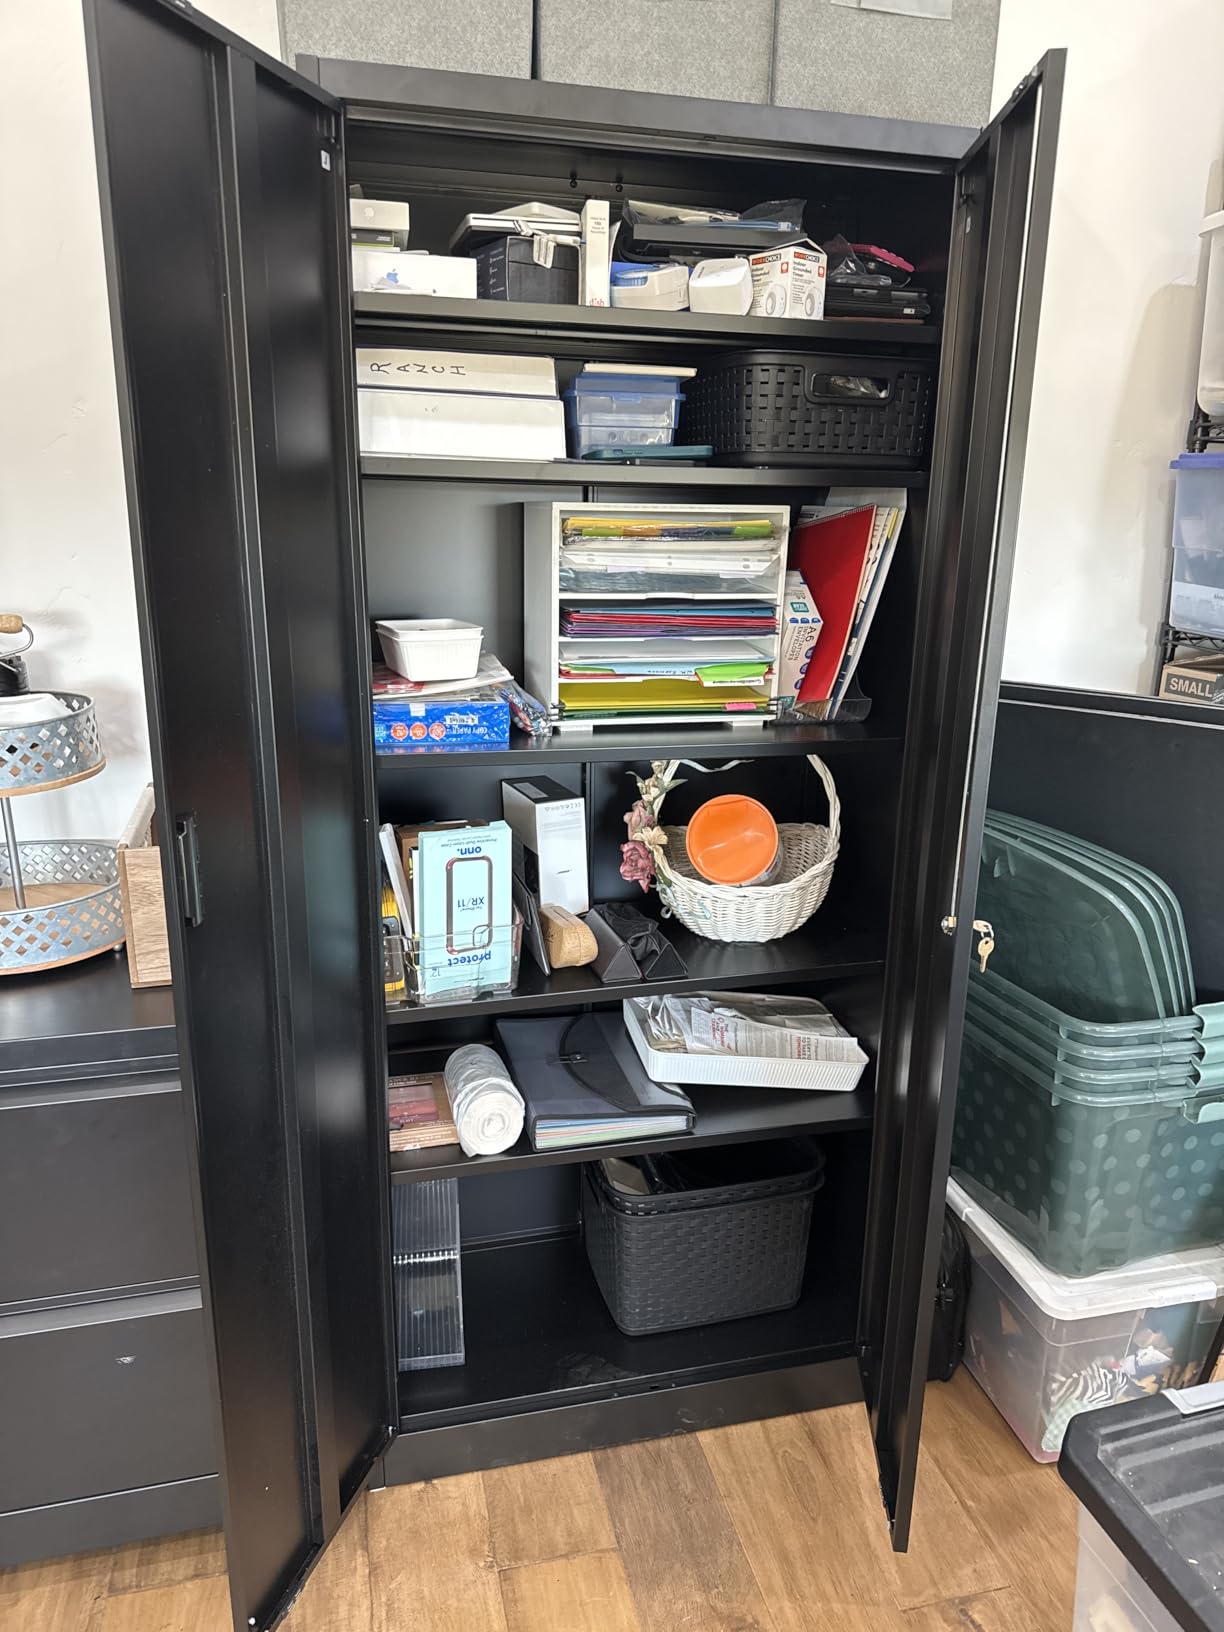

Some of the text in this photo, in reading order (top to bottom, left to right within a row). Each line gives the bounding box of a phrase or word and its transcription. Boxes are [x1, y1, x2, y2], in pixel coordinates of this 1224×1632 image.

[369, 362, 466, 376] RANCH
[804, 625, 817, 642] A6
[787, 625, 802, 661] ENVELOPES
[794, 625, 808, 661] INVITATION
[1169, 677, 1213, 698] SMALL
[472, 726, 488, 735] COPY
[457, 846, 482, 856] onn.
[457, 896, 485, 908] XR/11
[447, 951, 492, 967] protect
